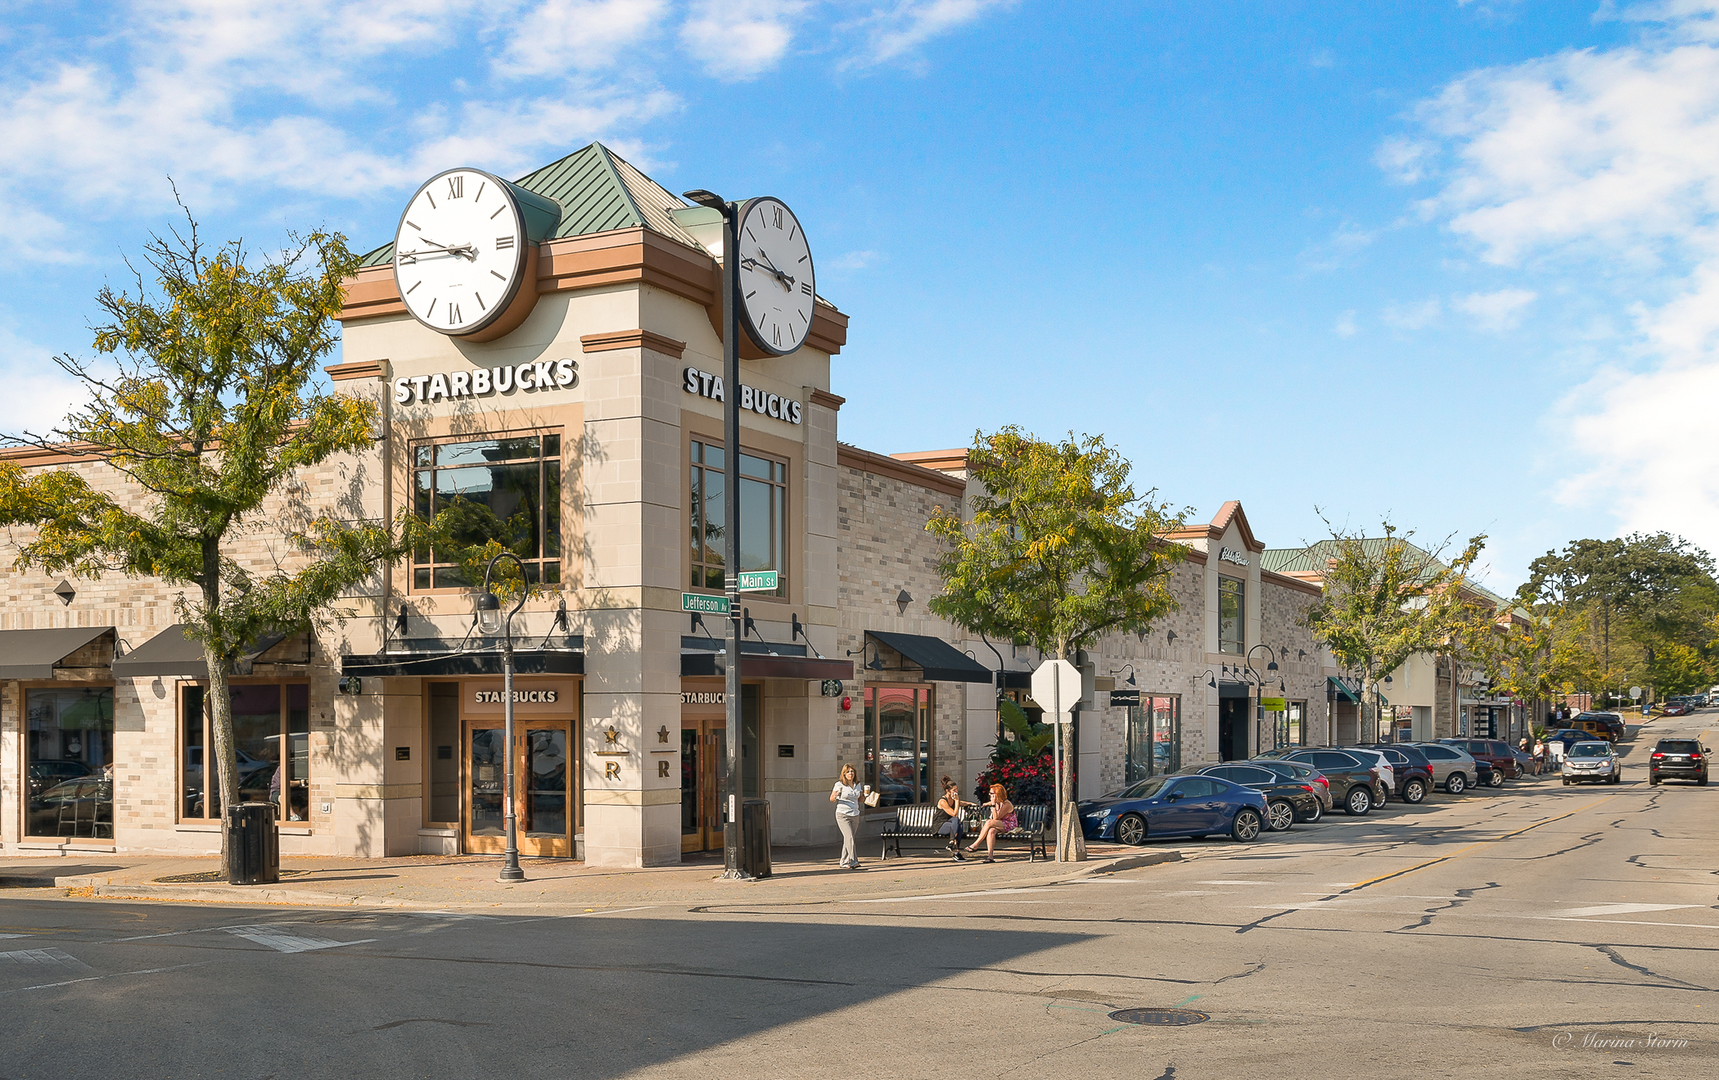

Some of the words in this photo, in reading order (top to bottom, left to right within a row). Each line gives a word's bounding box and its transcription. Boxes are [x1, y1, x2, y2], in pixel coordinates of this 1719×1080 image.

[447, 175, 464, 200] XII
[772, 204, 783, 231] XII
[496, 235, 514, 250] III
[801, 281, 812, 297] III
[449, 302, 463, 325] VI
[394, 358, 578, 405] STARBUCKS
[683, 366, 802, 425] STABUCKS
[741, 574, 763, 588] Main
[685, 596, 719, 613] Jefferson
[680, 692, 727, 704] STARBUCK
[605, 761, 621, 781] R
[658, 760, 670, 778] R
